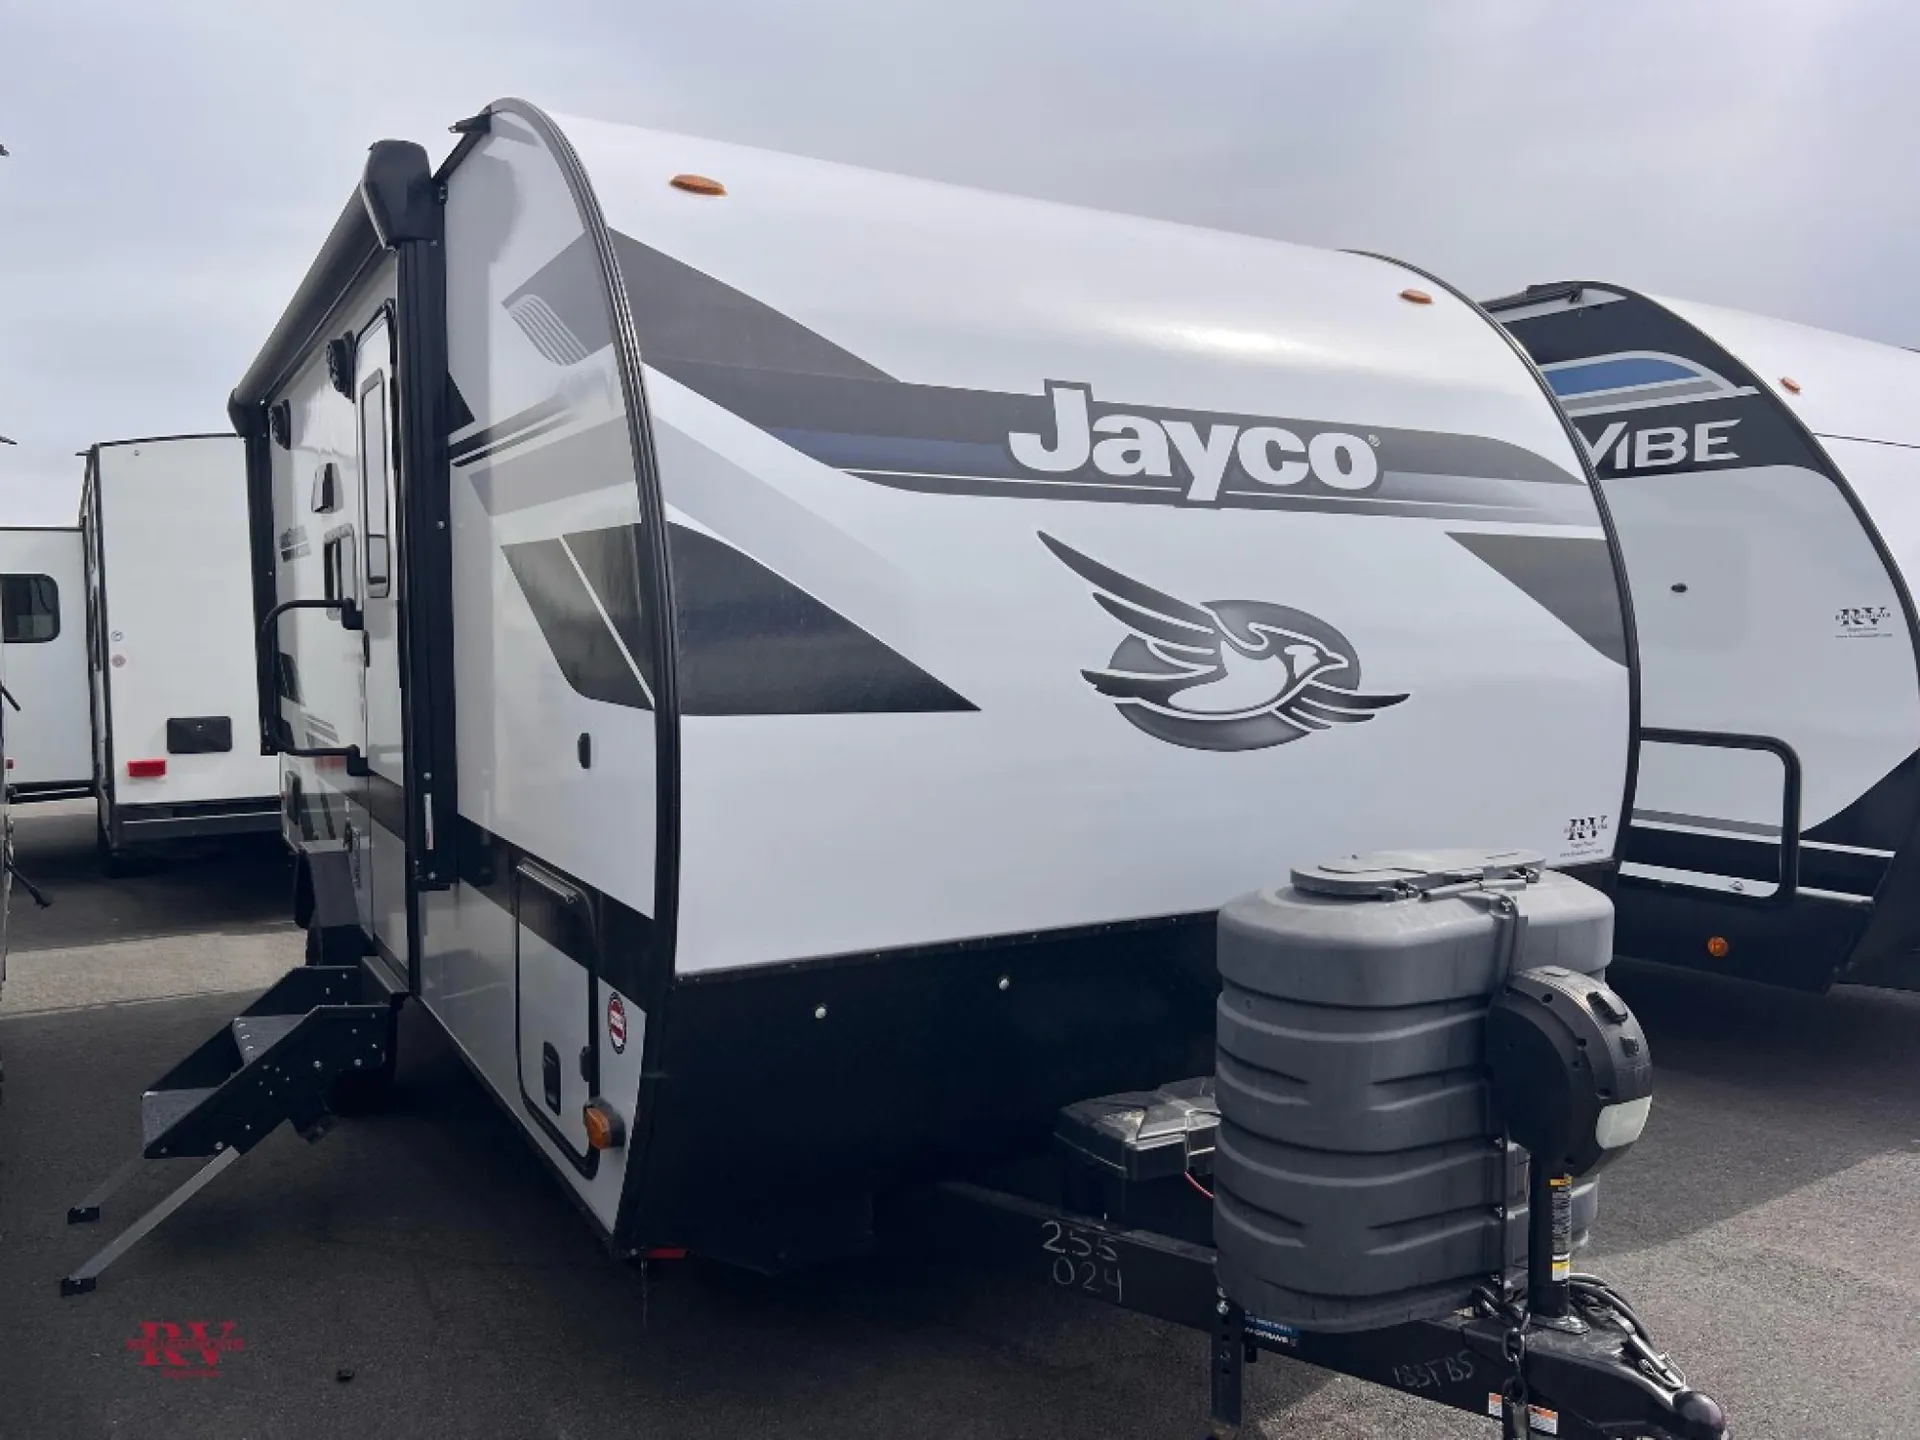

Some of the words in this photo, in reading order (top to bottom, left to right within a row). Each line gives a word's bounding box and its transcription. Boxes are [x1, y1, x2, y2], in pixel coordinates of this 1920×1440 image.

[1008, 386, 1379, 502] Jayco
[1574, 417, 1743, 470] VIBE
[1042, 1220, 1118, 1261] 255
[1053, 1256, 1122, 1303] 024
